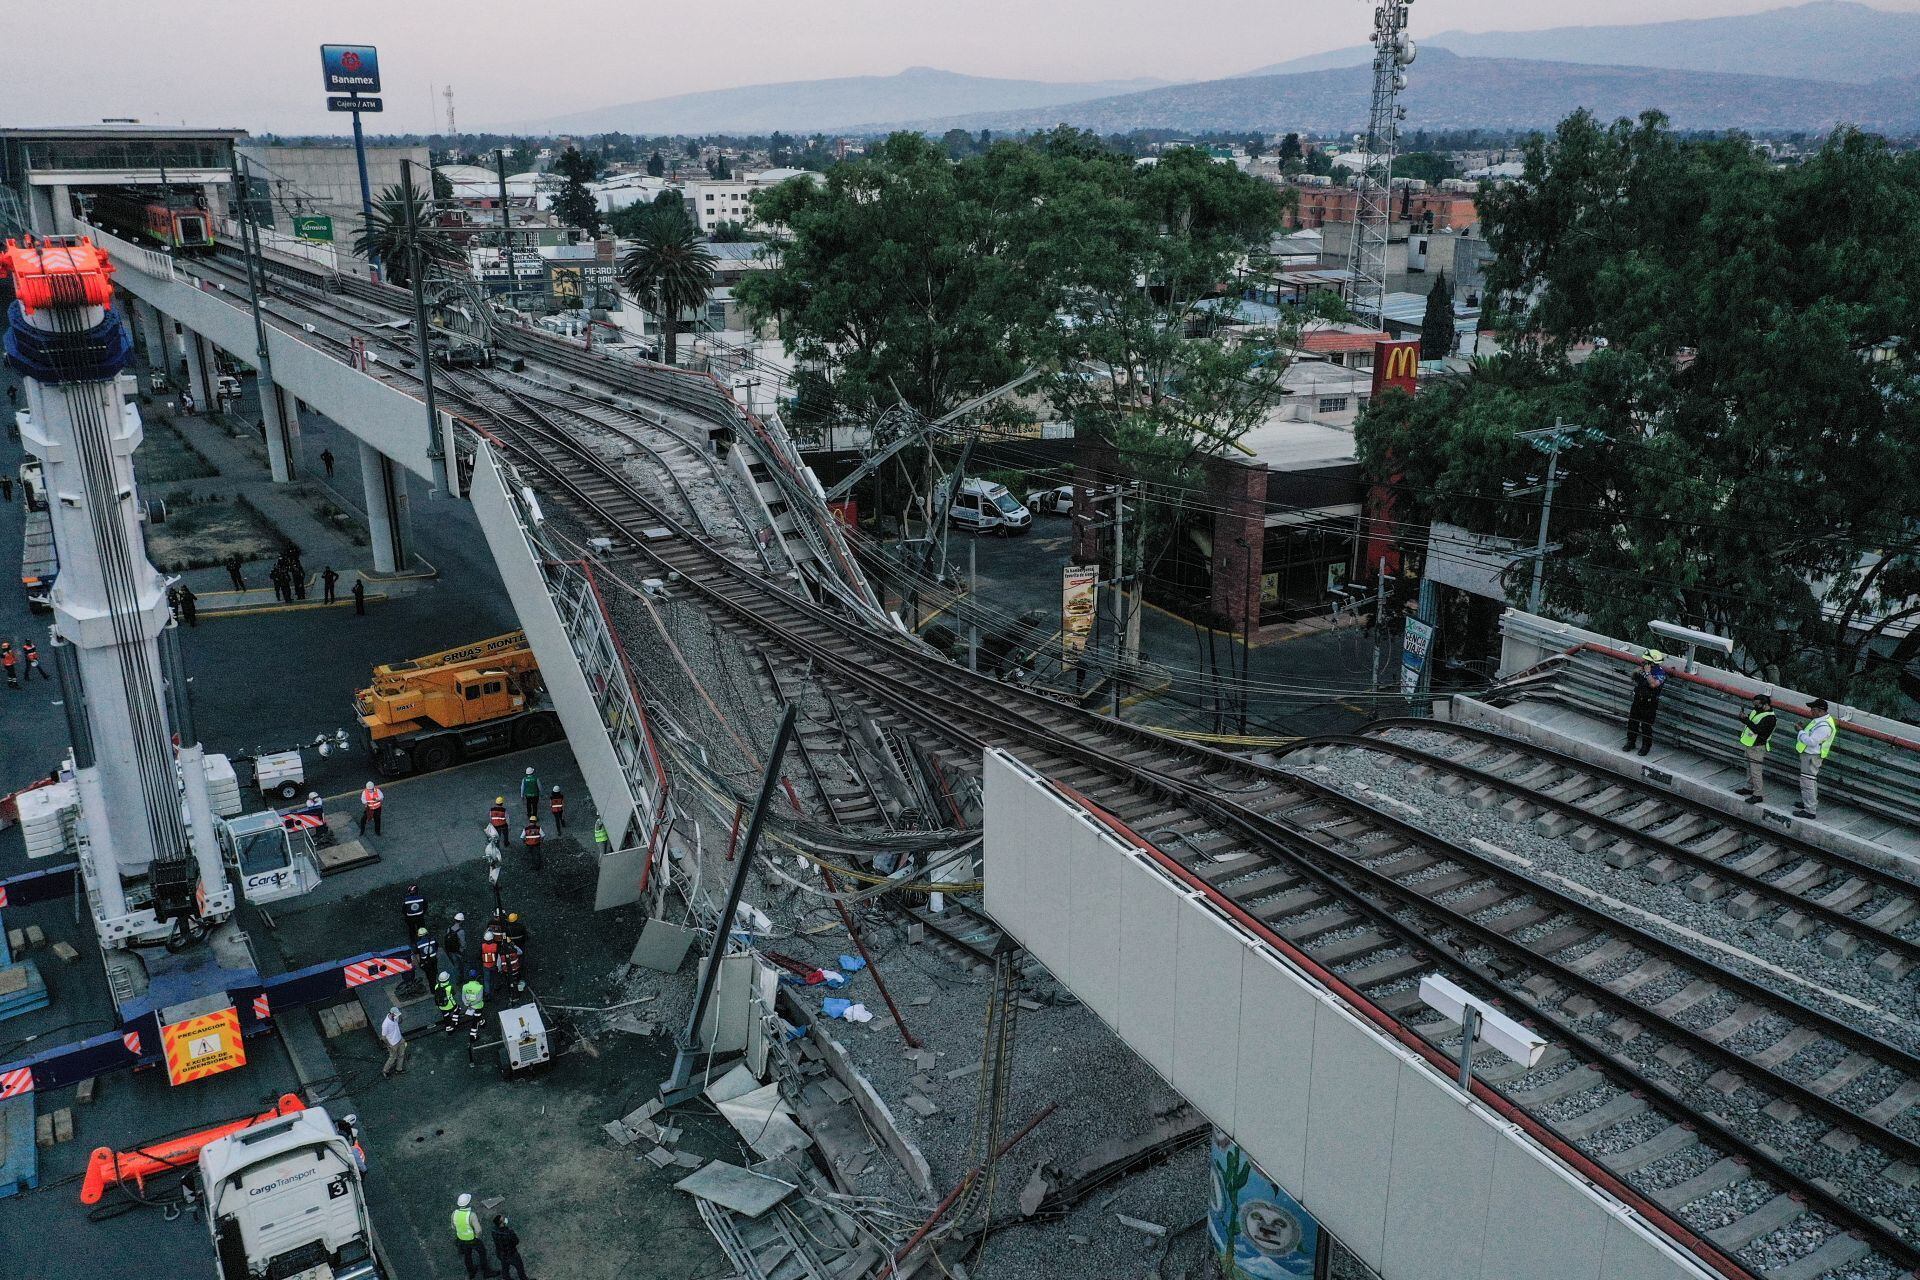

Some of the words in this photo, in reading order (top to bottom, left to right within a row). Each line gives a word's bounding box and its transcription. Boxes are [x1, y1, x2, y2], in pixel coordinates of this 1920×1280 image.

[331, 75, 374, 85] Banamex
[336, 101, 357, 109] Cajero
[443, 646, 482, 662] GRUAS
[248, 871, 289, 887] Cargo
[182, 1054, 233, 1072] DIMENSIONES
[185, 1054, 217, 1067] EXCESO
[331, 1181, 345, 1196] 3
